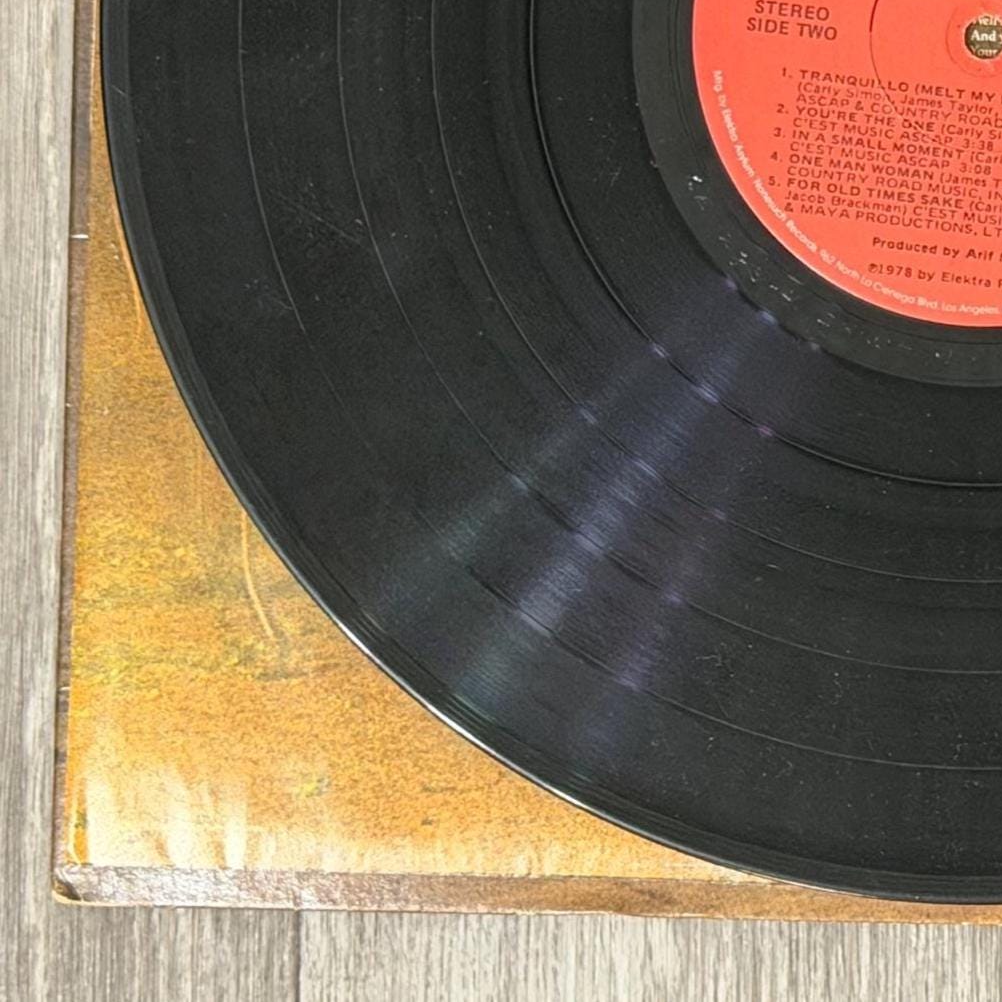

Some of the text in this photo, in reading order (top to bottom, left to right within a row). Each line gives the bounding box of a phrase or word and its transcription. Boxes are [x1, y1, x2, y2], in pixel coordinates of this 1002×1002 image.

[754, 0, 830, 22] STEREO
[746, 16, 838, 41] SIDE TWO
[970, 29, 997, 42] And
[782, 67, 793, 78] 1.
[799, 69, 909, 92] TRANQUILO
[914, 83, 965, 99] (MELT
[971, 90, 996, 102] MY
[797, 81, 841, 96] (Carly
[900, 94, 943, 109] James
[796, 93, 849, 107] ASCAP
[855, 100, 864, 112] &
[870, 102, 952, 120] COUNTRY
[776, 103, 789, 114] 2.
[795, 105, 858, 122] YOU'RE
[865, 113, 896, 127] THE
[901, 118, 935, 132] ONE
[940, 124, 983, 139] (Carly
[792, 117, 994, 152] C'EST MUSIC 3:38
[773, 127, 786, 138] 3.
[792, 129, 810, 141] IN
[815, 133, 826, 143] A
[831, 134, 887, 151] SMALL
[892, 142, 965, 160] MOMENT
[789, 153, 823, 168] ONE
[828, 158, 866, 172] MAN
[871, 163, 934, 180] WOMAN
[940, 172, 987, 188] (James
[790, 141, 992, 176] C'EST MUSIC ASCAP 3:08
[768, 176, 781, 187] 5.
[787, 178, 820, 192] FOR
[826, 183, 861, 196] OLD
[866, 188, 915, 204] TIMES
[920, 194, 964, 209] SAKE
[787, 166, 869, 184] COUNTRY
[875, 176, 923, 191] ROAD
[783, 202, 794, 213] &
[800, 204, 850, 219] MAYA
[785, 190, 826, 204] Jacob
[831, 195, 907, 216] Brackman)
[913, 205, 957, 220] C'EST
[872, 236, 938, 255] Produced
[942, 247, 960, 259] by
[965, 248, 994, 261] Arif
[917, 269, 936, 282] by
[941, 271, 991, 288] Elektra
